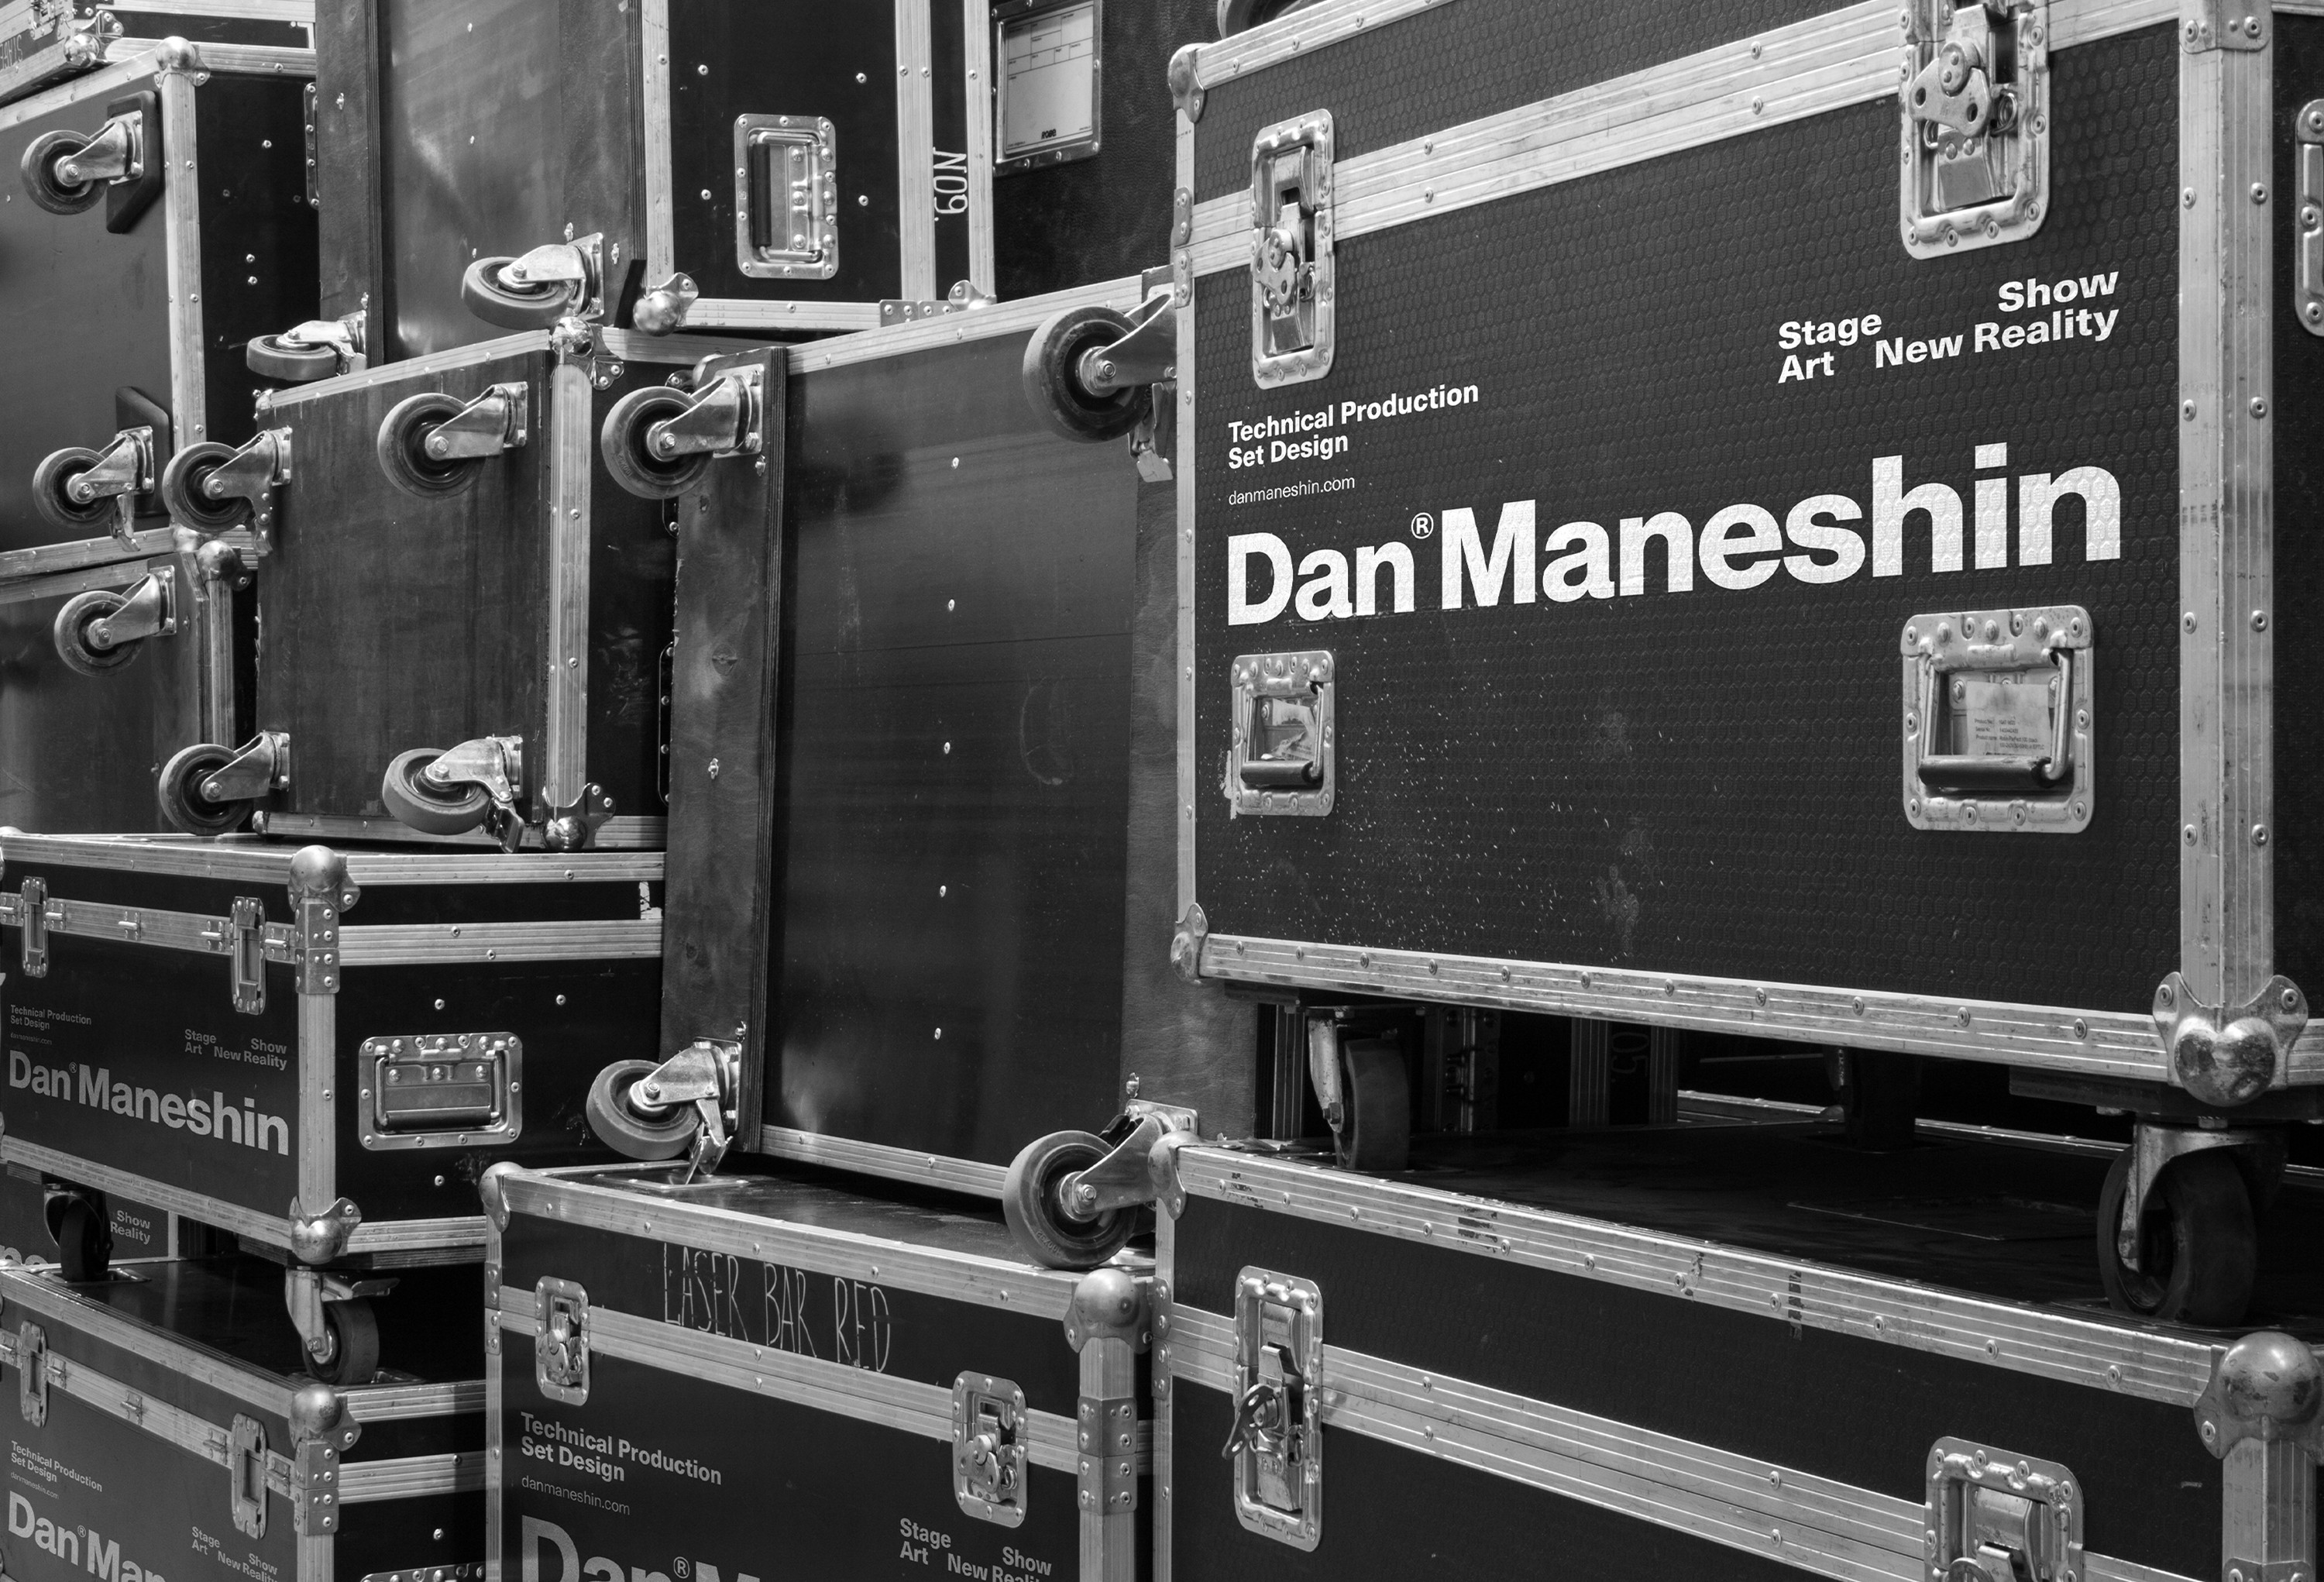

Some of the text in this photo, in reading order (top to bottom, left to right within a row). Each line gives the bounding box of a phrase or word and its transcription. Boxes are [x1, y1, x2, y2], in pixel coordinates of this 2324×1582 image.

[1998, 271, 2119, 312] Show
[1778, 313, 1882, 349] Stage
[1875, 309, 2119, 369] New Reality
[1778, 350, 1834, 384] Art
[1229, 384, 1479, 443] Technical Production
[1229, 435, 1349, 469] Set Design
[1229, 476, 1356, 505] danmaneshin.com
[1442, 442, 2121, 610] Maneshin
[10, 1004, 92, 1026] Technical Production
[10, 1015, 50, 1030] Set Design
[184, 1029, 216, 1045] Stage
[184, 1042, 203, 1055] Art
[250, 1038, 287, 1054] Show
[214, 1046, 287, 1071] New Reality
[78, 1063, 289, 1156] Maneshin
[110, 1221, 151, 1245] Reality
[116, 1210, 151, 1229] Show
[664, 1243, 891, 1373] LASER BAR RED
[521, 1411, 722, 1485] Technical Production
[521, 1436, 624, 1482] Set Design
[11, 1453, 57, 1483] Set Design
[12, 1440, 102, 1492] Technical Production
[11, 1471, 60, 1499] danmaneshin.com
[521, 1475, 631, 1515] danmaneshin.com
[191, 1526, 220, 1548] Stage
[191, 1539, 208, 1555] Art
[899, 1518, 951, 1549] Stage
[218, 1550, 241, 1570] New
[249, 1553, 278, 1575] Show
[899, 1541, 929, 1565] Art
[947, 1553, 988, 1581] New
[1002, 1546, 1052, 1576] Show
